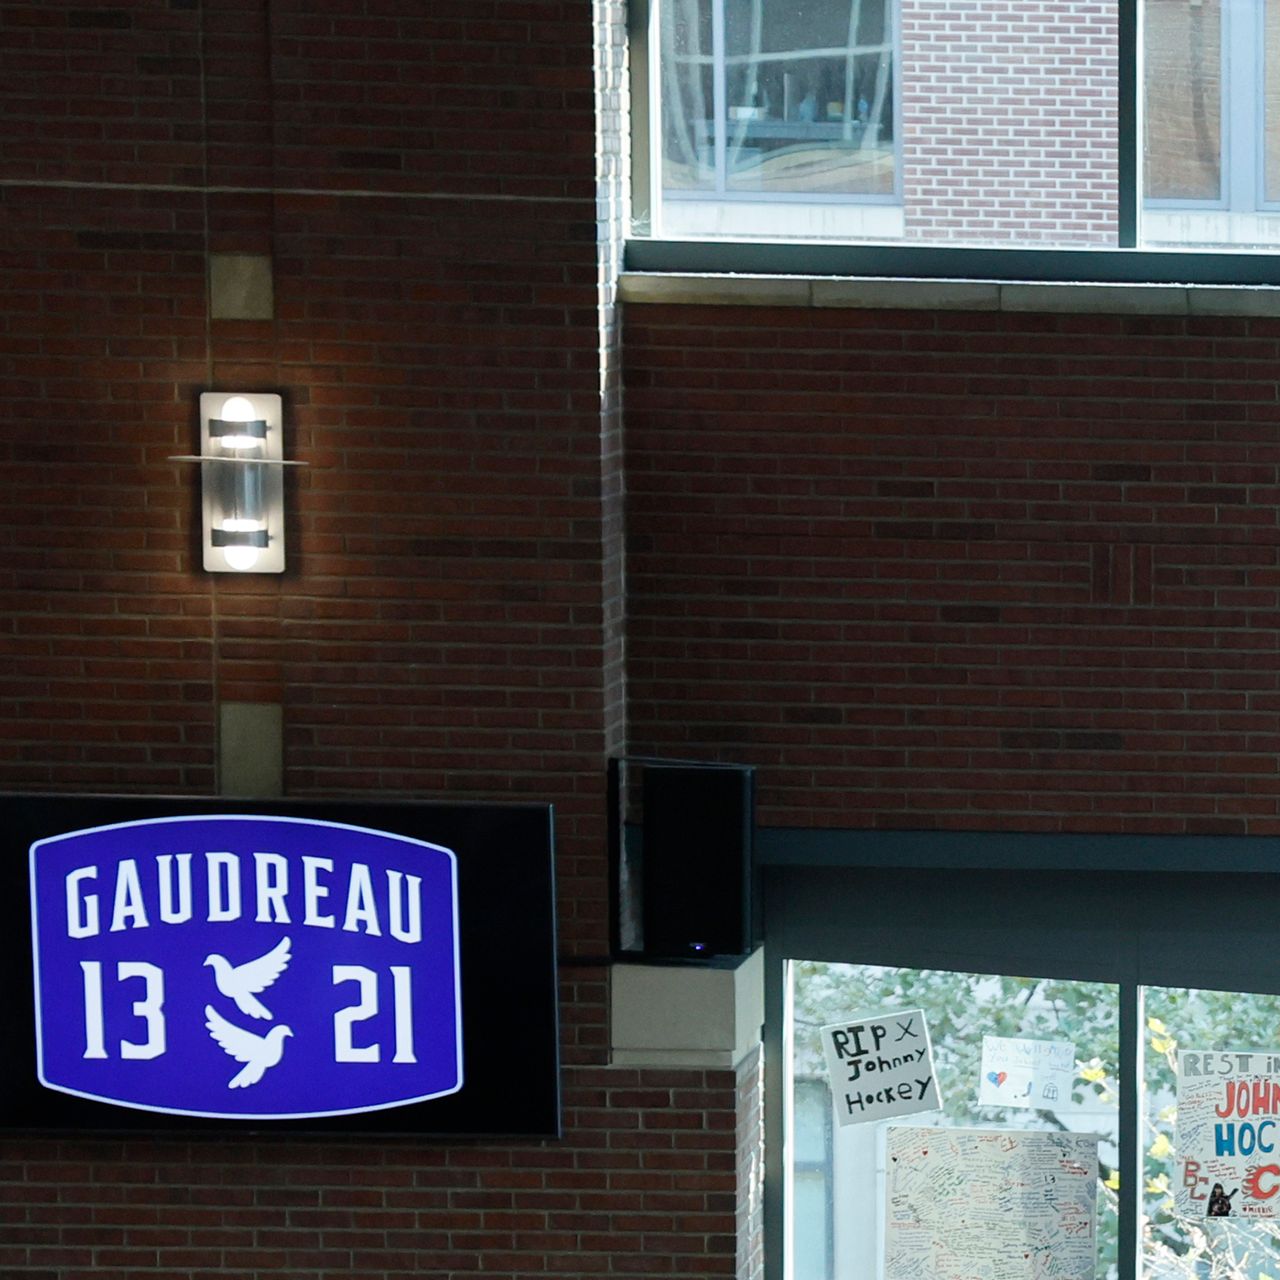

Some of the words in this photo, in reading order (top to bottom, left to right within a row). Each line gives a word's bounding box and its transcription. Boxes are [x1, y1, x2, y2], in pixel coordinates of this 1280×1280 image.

[65, 852, 423, 943] GAUDREAU
[80, 961, 167, 1060] 13
[331, 965, 418, 1064] 21
[831, 1025, 887, 1059] RIP
[847, 1048, 927, 1082] Johnny
[1184, 1054, 1253, 1076] REST
